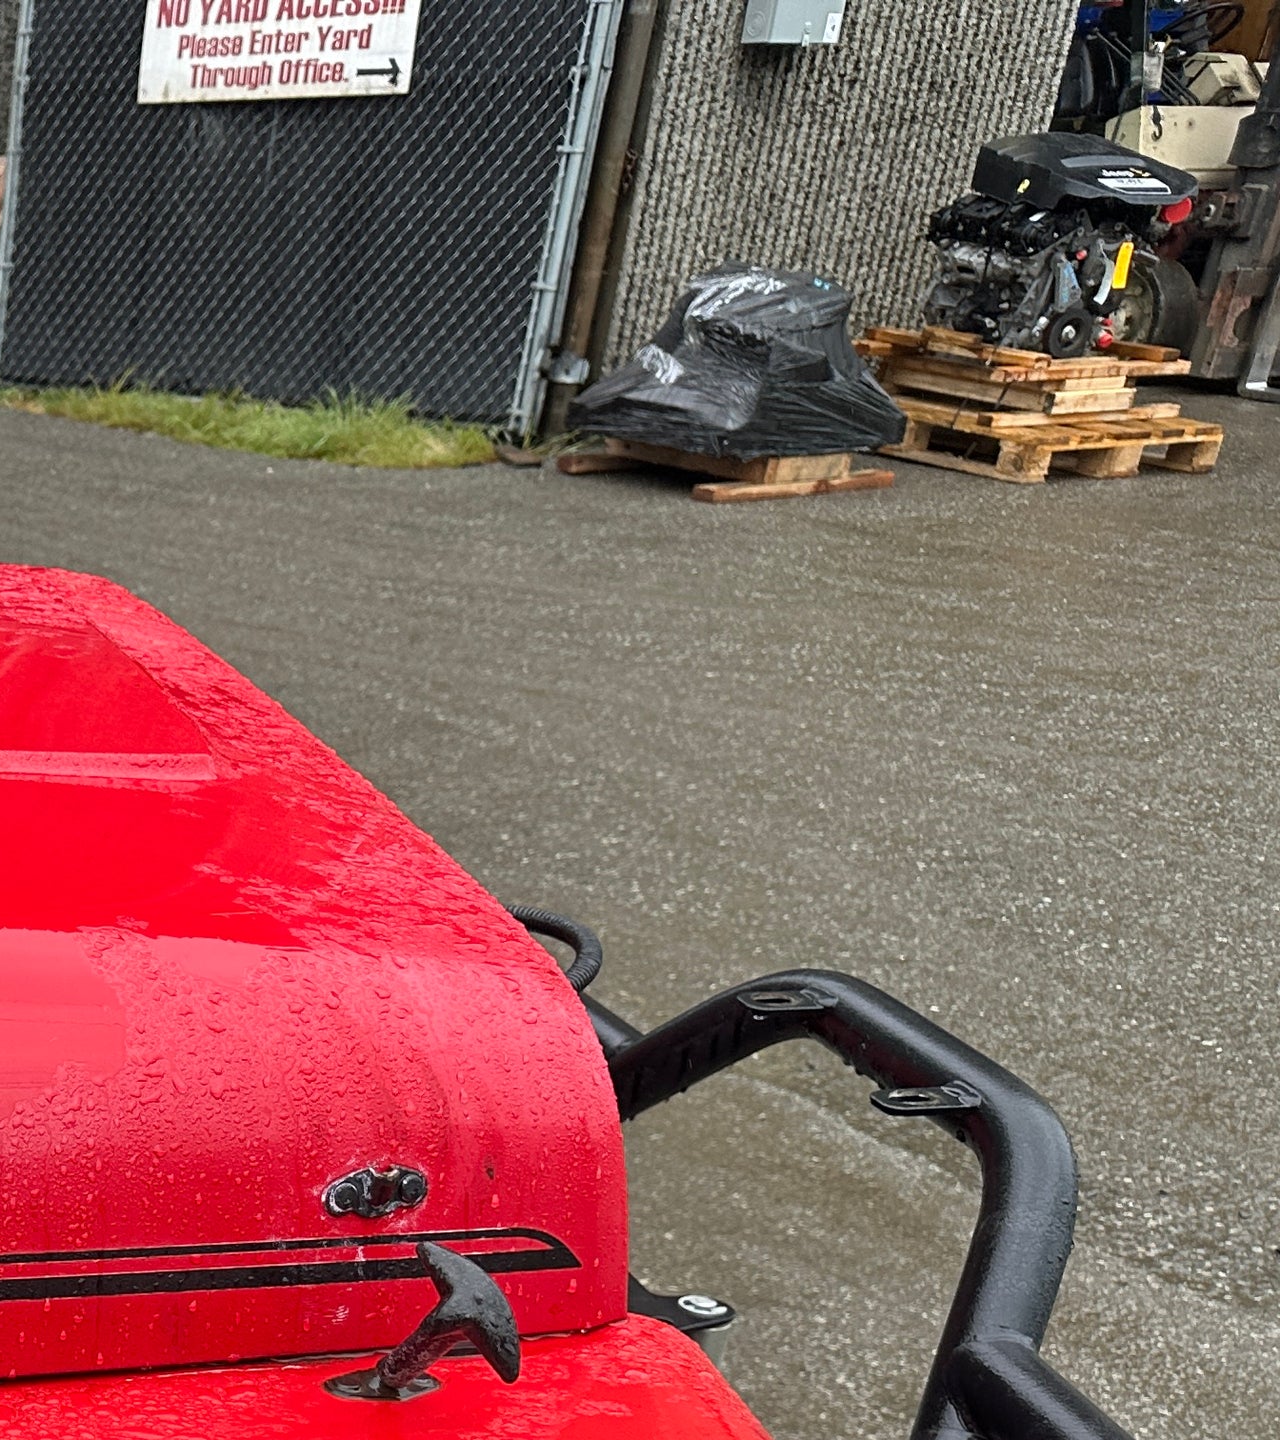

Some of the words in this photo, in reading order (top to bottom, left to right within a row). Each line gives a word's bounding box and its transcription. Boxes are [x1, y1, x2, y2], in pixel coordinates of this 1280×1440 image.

[157, 0, 190, 28] NO
[200, 0, 269, 26] YARD
[177, 34, 242, 59] Please
[249, 30, 309, 55] Enter
[317, 24, 373, 50] Yard
[190, 61, 272, 90] Through
[279, 59, 349, 85] Office.
